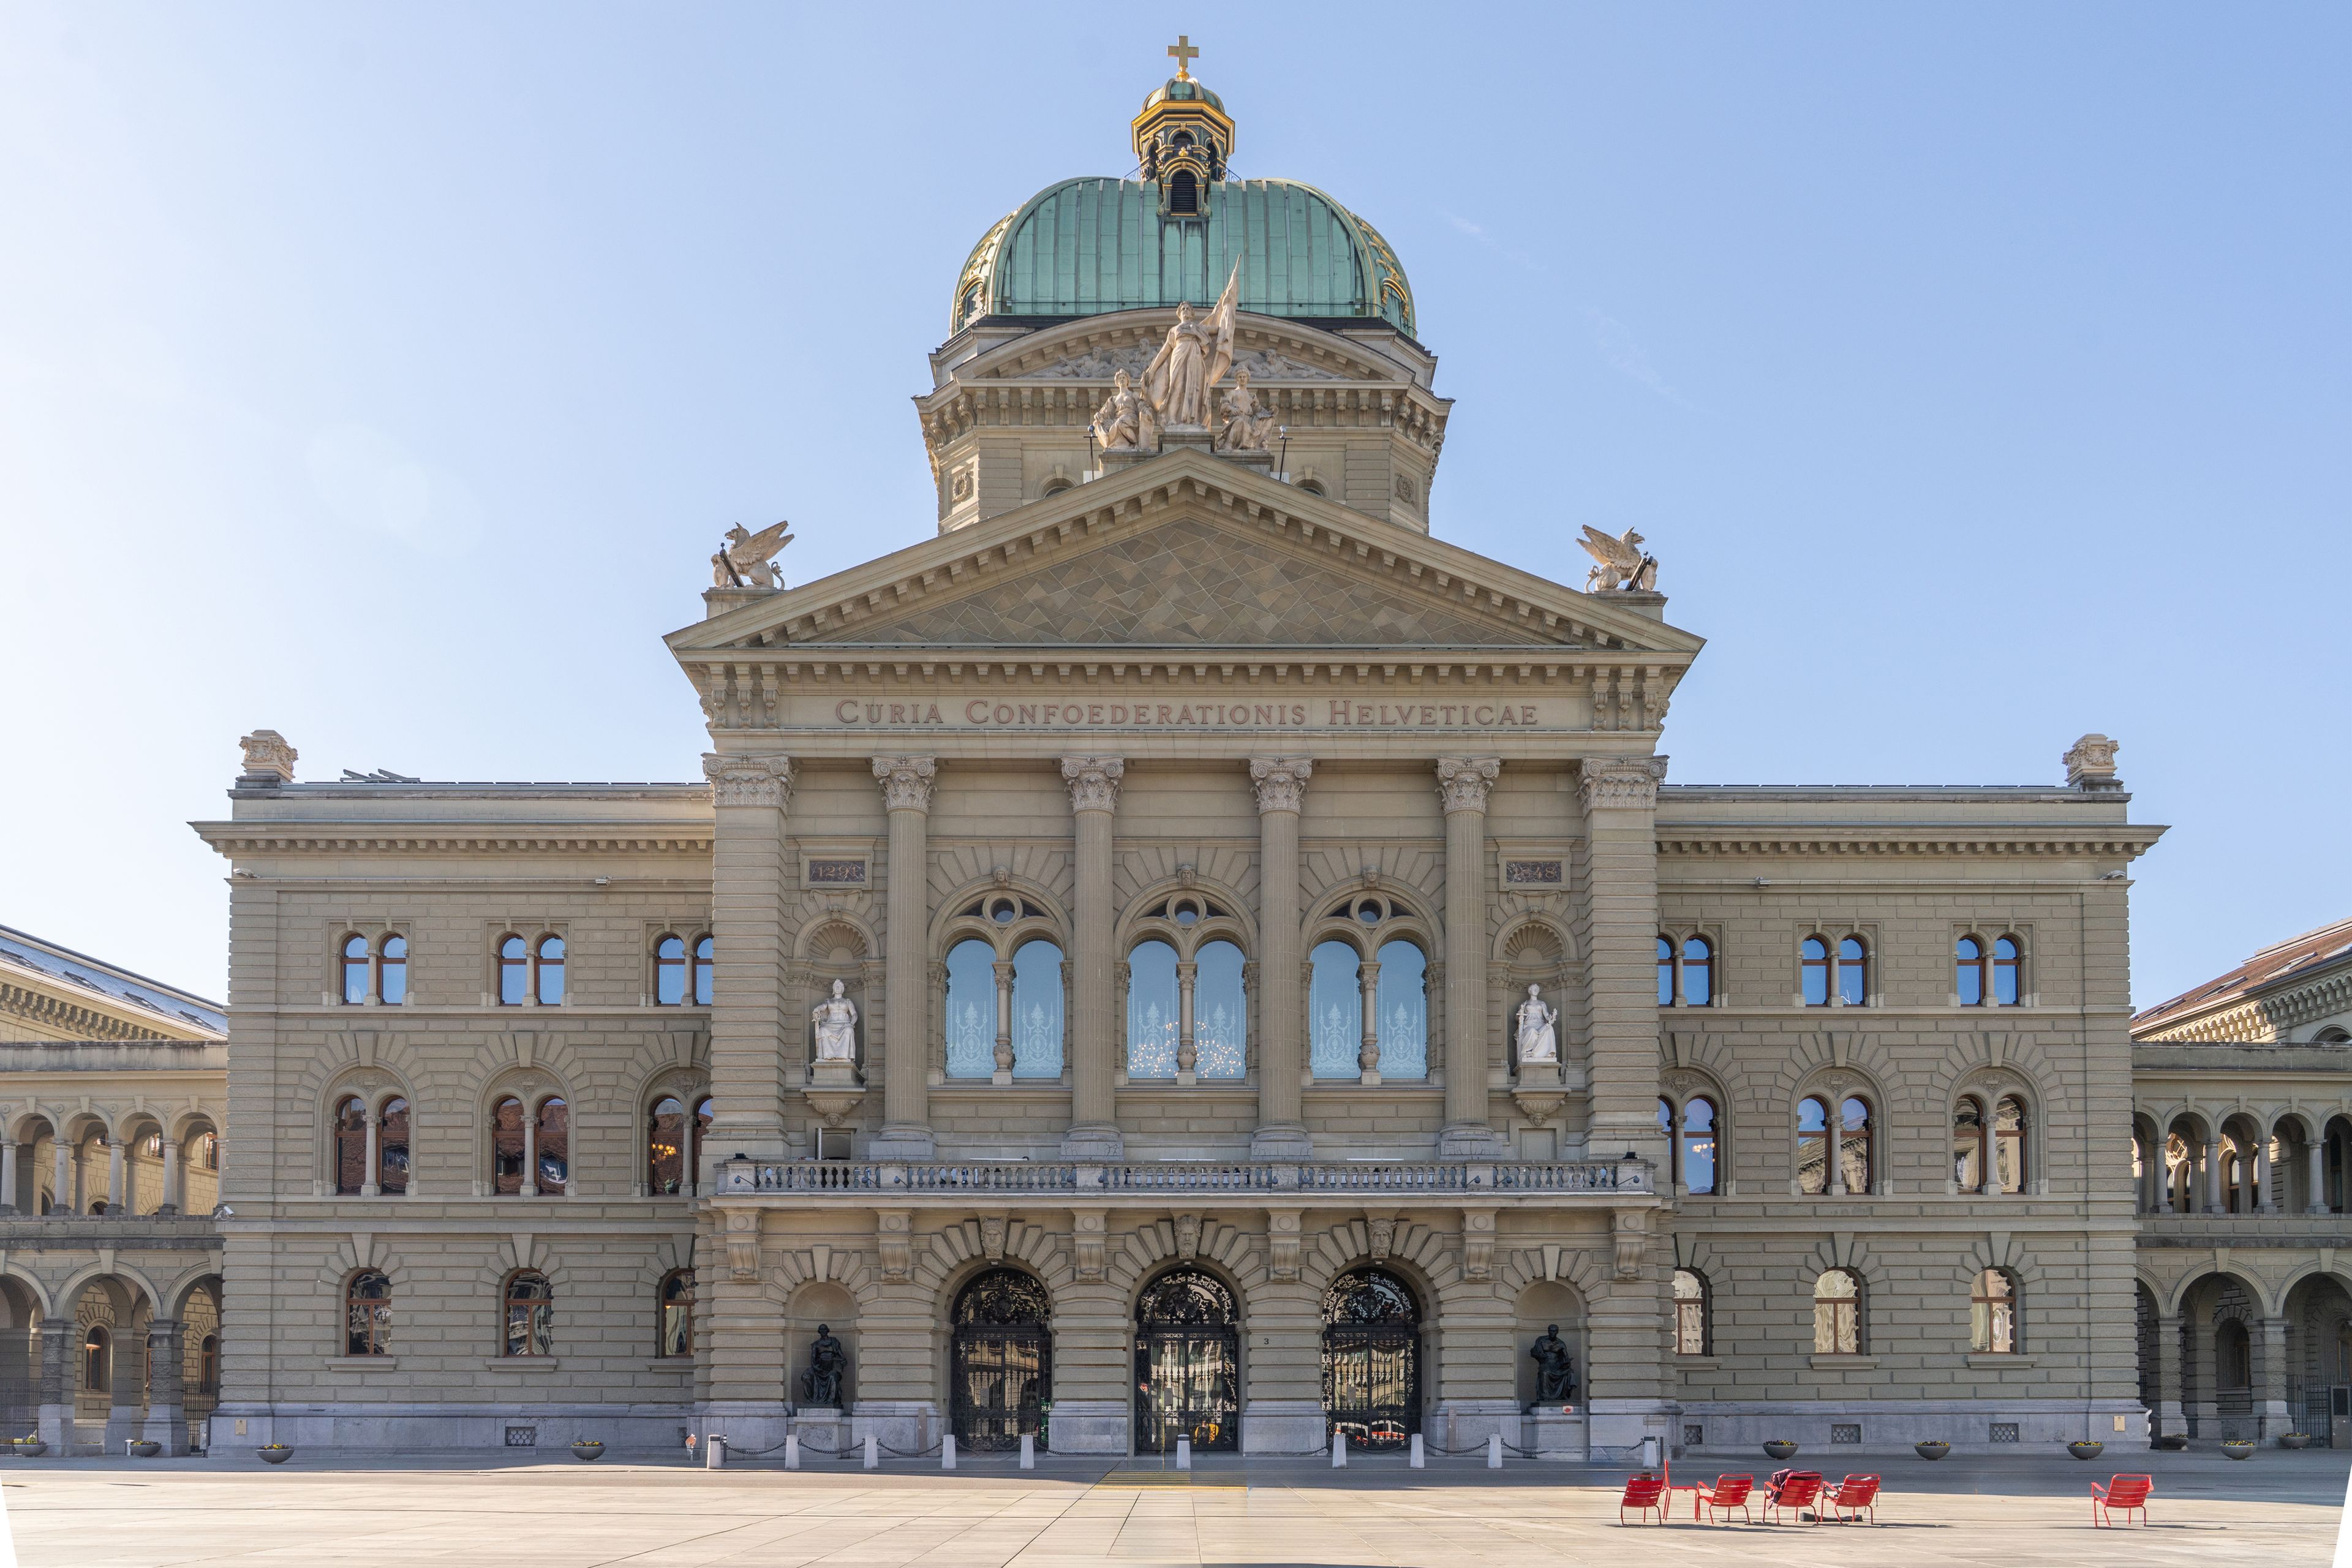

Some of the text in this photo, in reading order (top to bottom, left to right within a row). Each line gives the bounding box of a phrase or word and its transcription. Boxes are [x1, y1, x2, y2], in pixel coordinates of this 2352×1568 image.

[835, 699, 1538, 725] CURIA CONFOEDERATIONIS HELVETICAE
[817, 865, 858, 878] 1291
